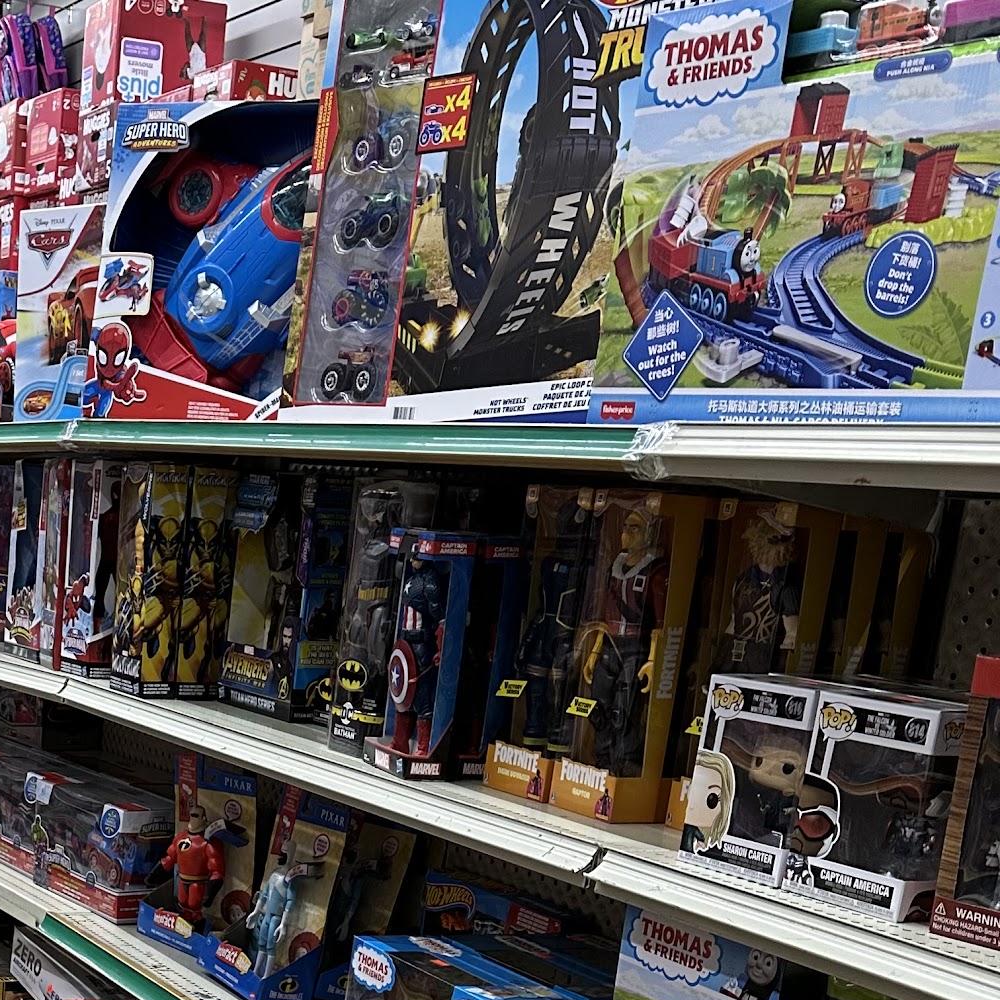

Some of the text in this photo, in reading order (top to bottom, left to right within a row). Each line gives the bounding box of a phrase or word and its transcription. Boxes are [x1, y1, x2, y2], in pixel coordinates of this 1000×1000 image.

[664, 25, 764, 67] THOMAS
[667, 55, 752, 87] & FRIENDS
[443, 84, 471, 113] x4
[125, 122, 186, 141] SUPER HERO
[440, 115, 467, 143] x4
[496, 56, 596, 336] HOT WHEELS
[31, 233, 66, 247] Cars
[888, 268, 912, 281] Don't
[878, 278, 914, 294] drop the
[876, 290, 909, 305] barrels!
[654, 307, 673, 323] 当心
[646, 320, 680, 341] 那些树!
[648, 339, 677, 356] Watch
[638, 351, 686, 371] out for the
[648, 364, 675, 381] trees!
[543, 391, 582, 401] PAQUETE DE
[551, 381, 585, 391] EPIC LOOP
[533, 402, 562, 411] COFFRET
[563, 401, 572, 409] DE
[222, 651, 272, 680] AVENGERS
[656, 626, 683, 699] FORTNITE
[713, 688, 744, 712] POP!
[820, 707, 857, 731] POP!
[333, 727, 355, 740] BATMAN
[494, 742, 540, 774] FORTNITE
[410, 763, 440, 776] MARVEL
[561, 760, 608, 792] FORTNITE
[224, 777, 252, 792] PIXAR
[320, 808, 344, 827] PIXAR
[722, 842, 773, 865] SHARON CARTER
[820, 868, 890, 897] CAPTAIN AMERICA
[641, 917, 712, 959] THOMAS
[951, 927, 974, 938] children
[975, 933, 991, 942] under
[14, 939, 42, 977] ZERO
[357, 951, 389, 975] THOMAS
[643, 939, 704, 973] & FRIENDS
[363, 965, 385, 983] FRIENDS
